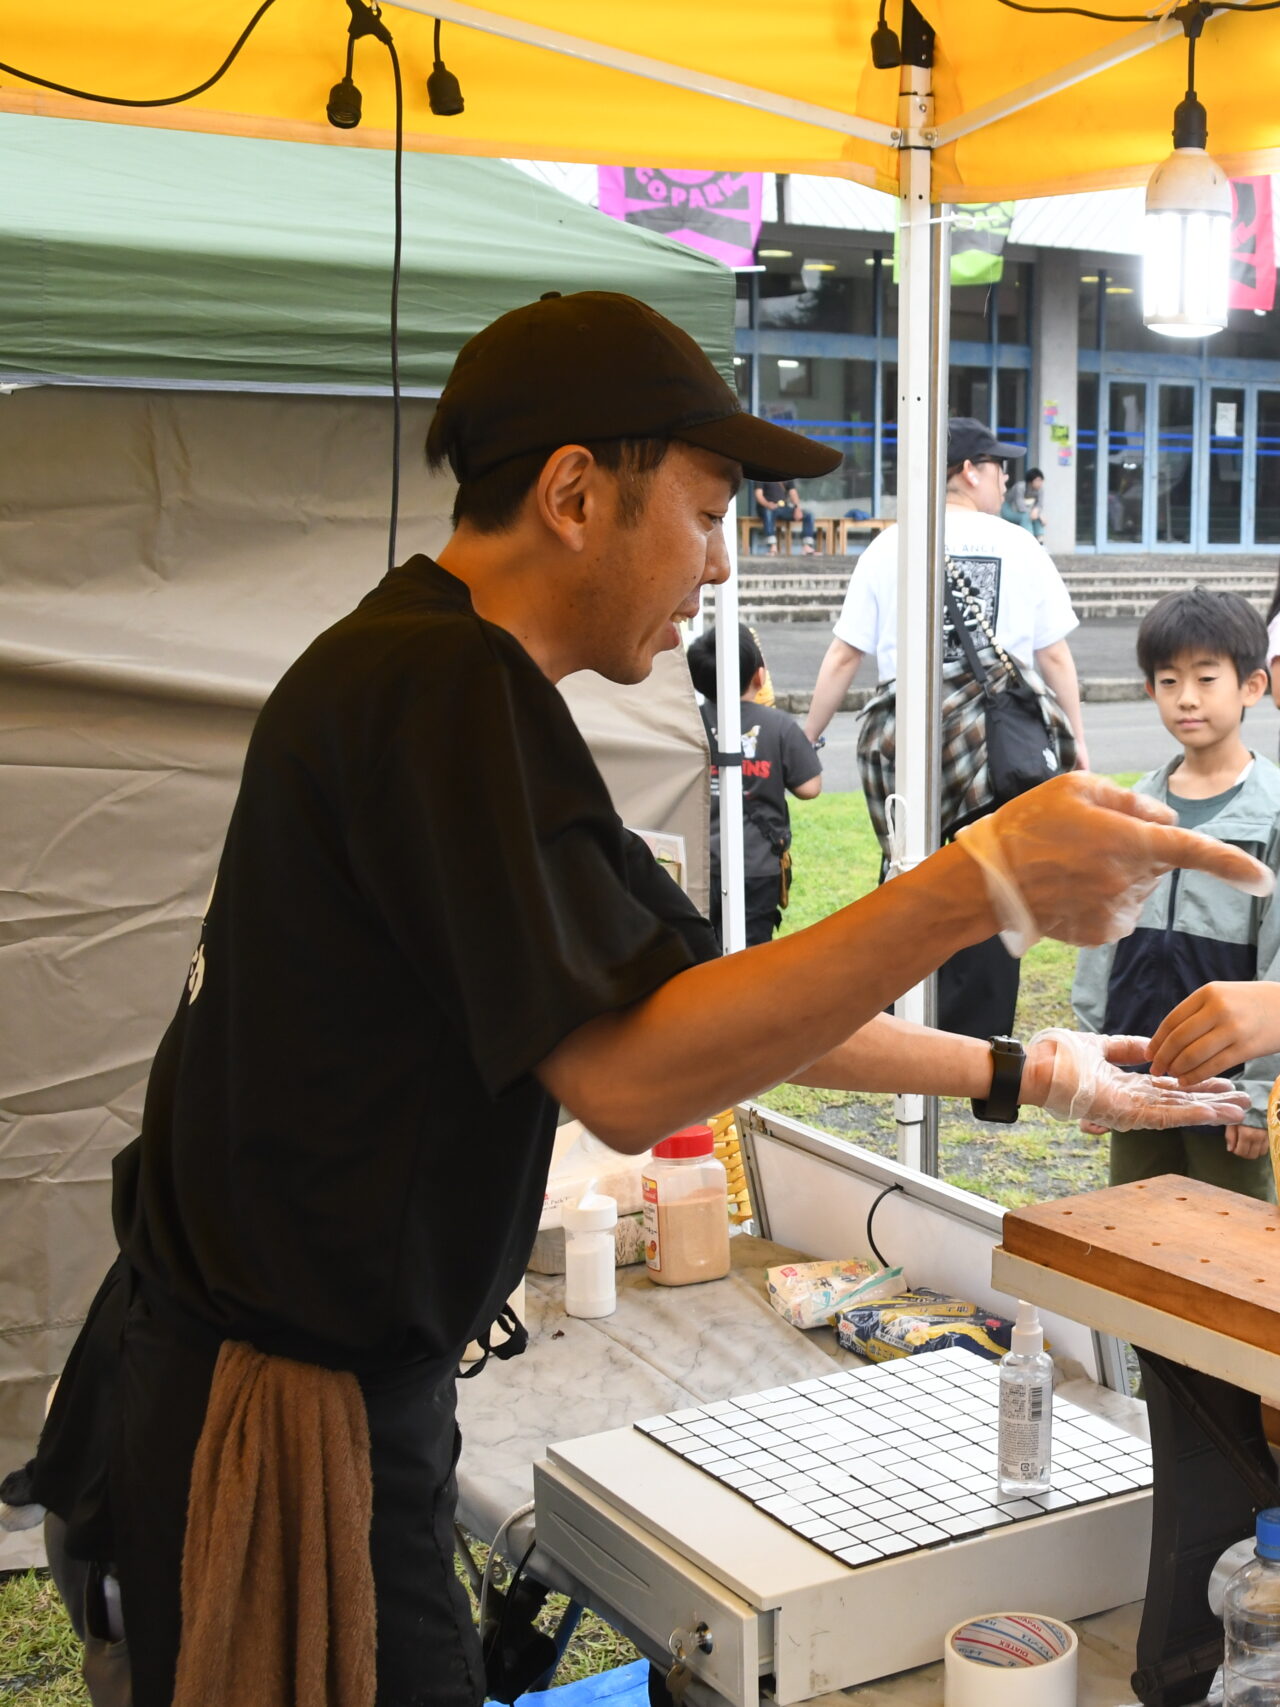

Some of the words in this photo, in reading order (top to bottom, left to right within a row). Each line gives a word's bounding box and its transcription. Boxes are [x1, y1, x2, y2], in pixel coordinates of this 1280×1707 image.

[635, 167, 744, 208] COPARK
[944, 543, 999, 553] ALANCE
[1000, 1639, 1029, 1658] DIATEX
